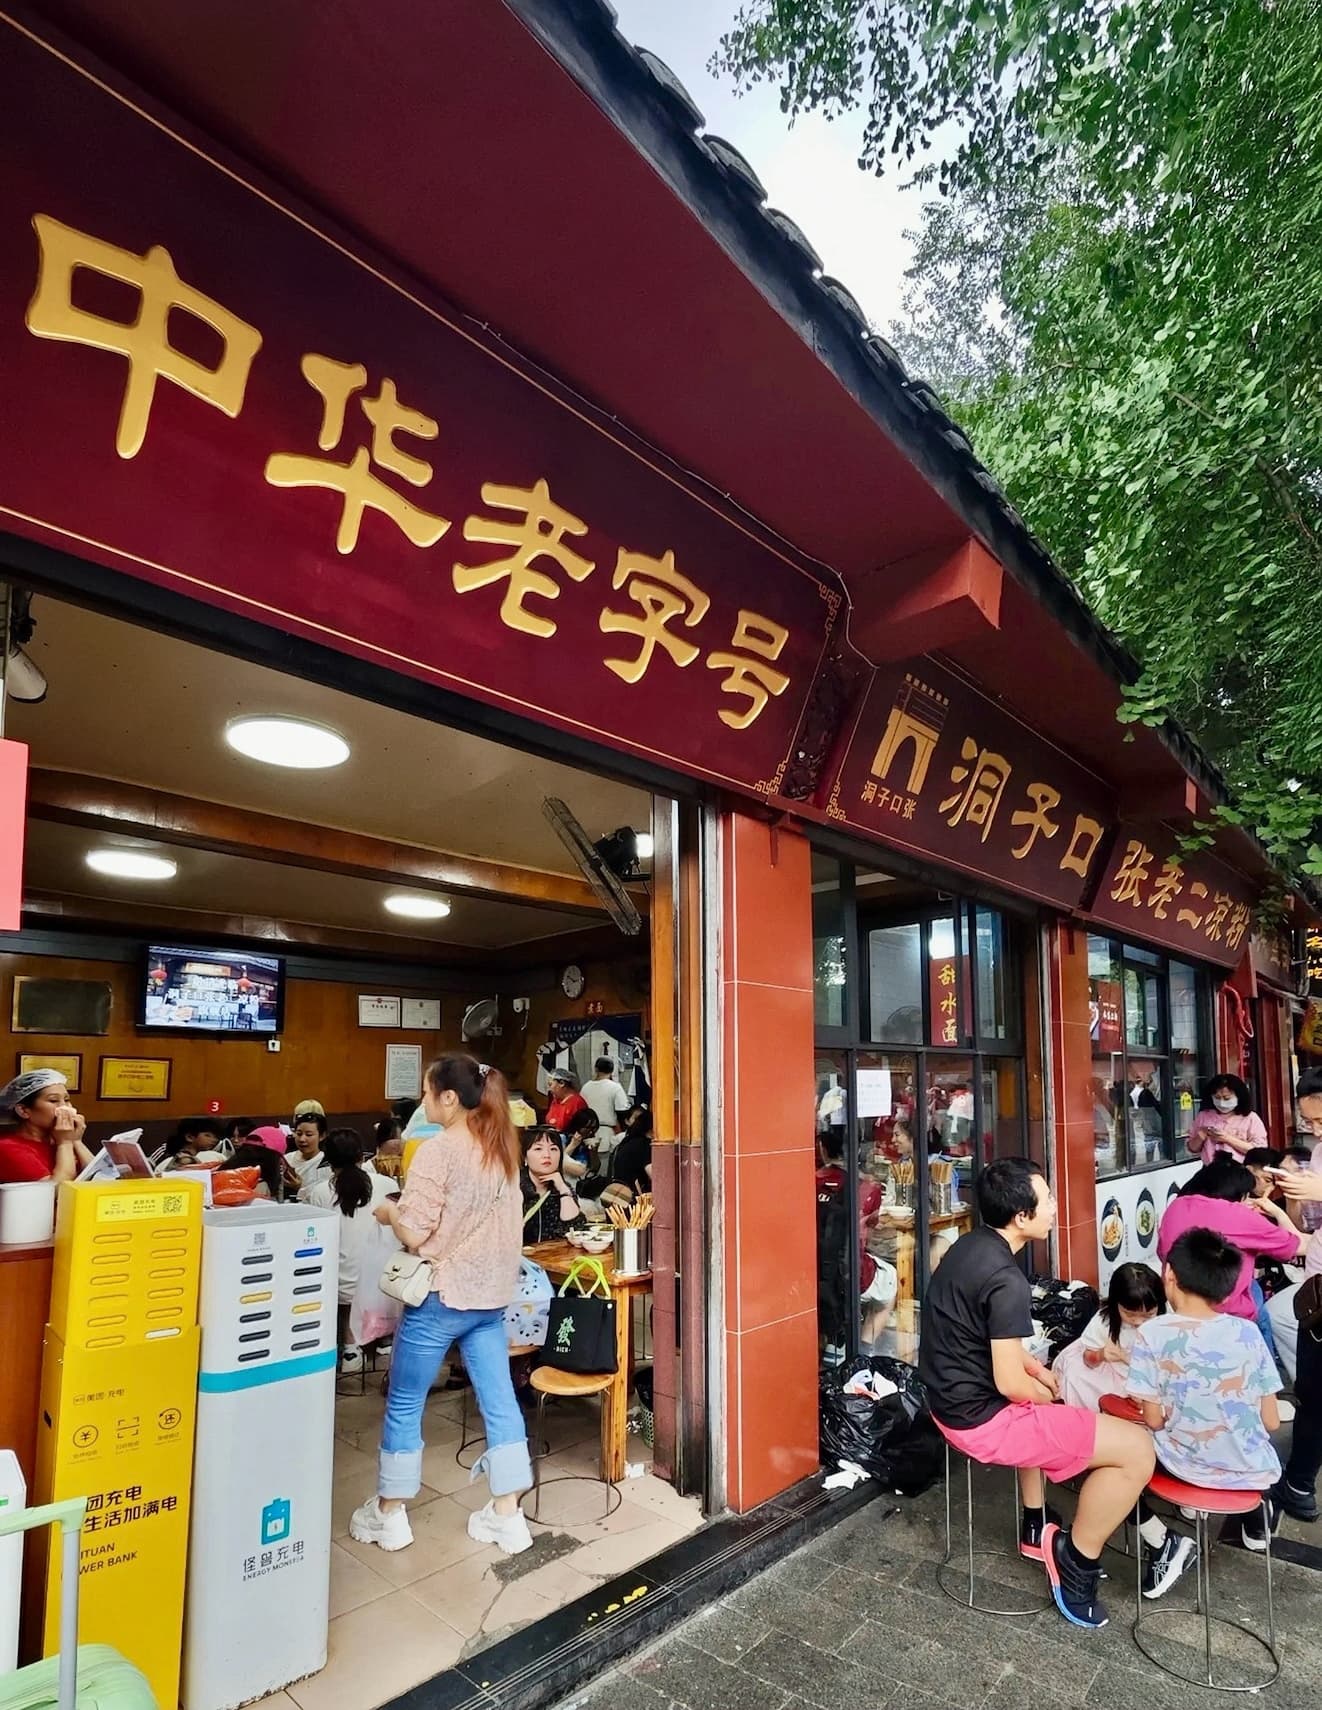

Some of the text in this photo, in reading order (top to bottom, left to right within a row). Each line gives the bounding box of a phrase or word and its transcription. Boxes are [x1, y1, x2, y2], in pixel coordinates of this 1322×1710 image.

[25, 213, 791, 732] 中华老字号
[861, 780, 917, 820] 洞子口张
[938, 736, 1105, 878] 洞子口
[1110, 840, 1250, 951] 张老二凉粉
[211, 1101, 220, 1112] 3
[84, 1496, 178, 1534] 生活加满电
[86, 1485, 142, 1513] 团充电
[79, 1551, 138, 1576] WER BANK
[80, 1542, 116, 1561] ITUAN
